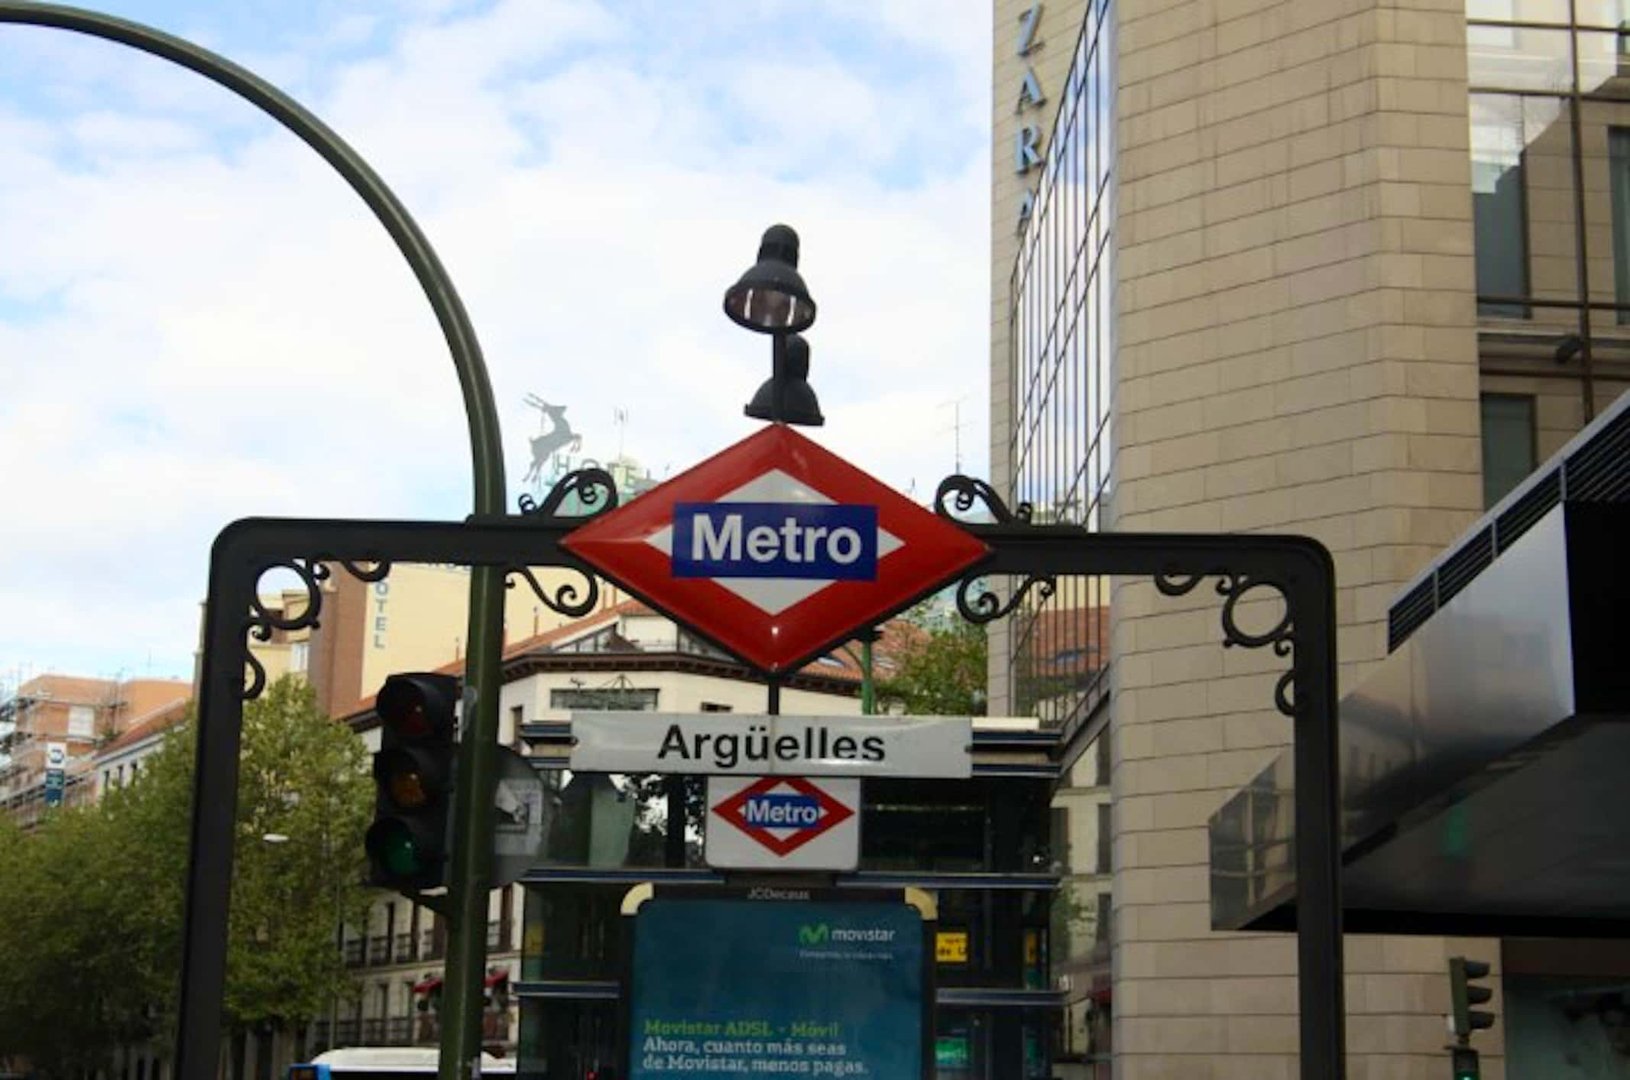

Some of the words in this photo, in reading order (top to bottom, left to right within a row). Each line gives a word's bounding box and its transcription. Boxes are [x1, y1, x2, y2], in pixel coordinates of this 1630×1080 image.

[1015, 1, 1046, 237] ZARA
[692, 513, 862, 565] Metro
[374, 581, 389, 650] OTEL
[657, 724, 886, 768] Argüelles
[747, 799, 818, 823] Metro
[831, 928, 895, 942] movistar
[644, 1020, 721, 1035] Movistar
[726, 1021, 773, 1037] ADSL
[791, 1021, 839, 1037] Móvil
[643, 1036, 700, 1054] Ahora,
[703, 1040, 762, 1053] cuanto
[767, 1038, 802, 1054] más
[807, 1043, 846, 1055] seas
[643, 1053, 664, 1069] de
[668, 1055, 749, 1072] Movistar,
[752, 1060, 809, 1072] menos
[813, 1061, 869, 1077] pagas.
